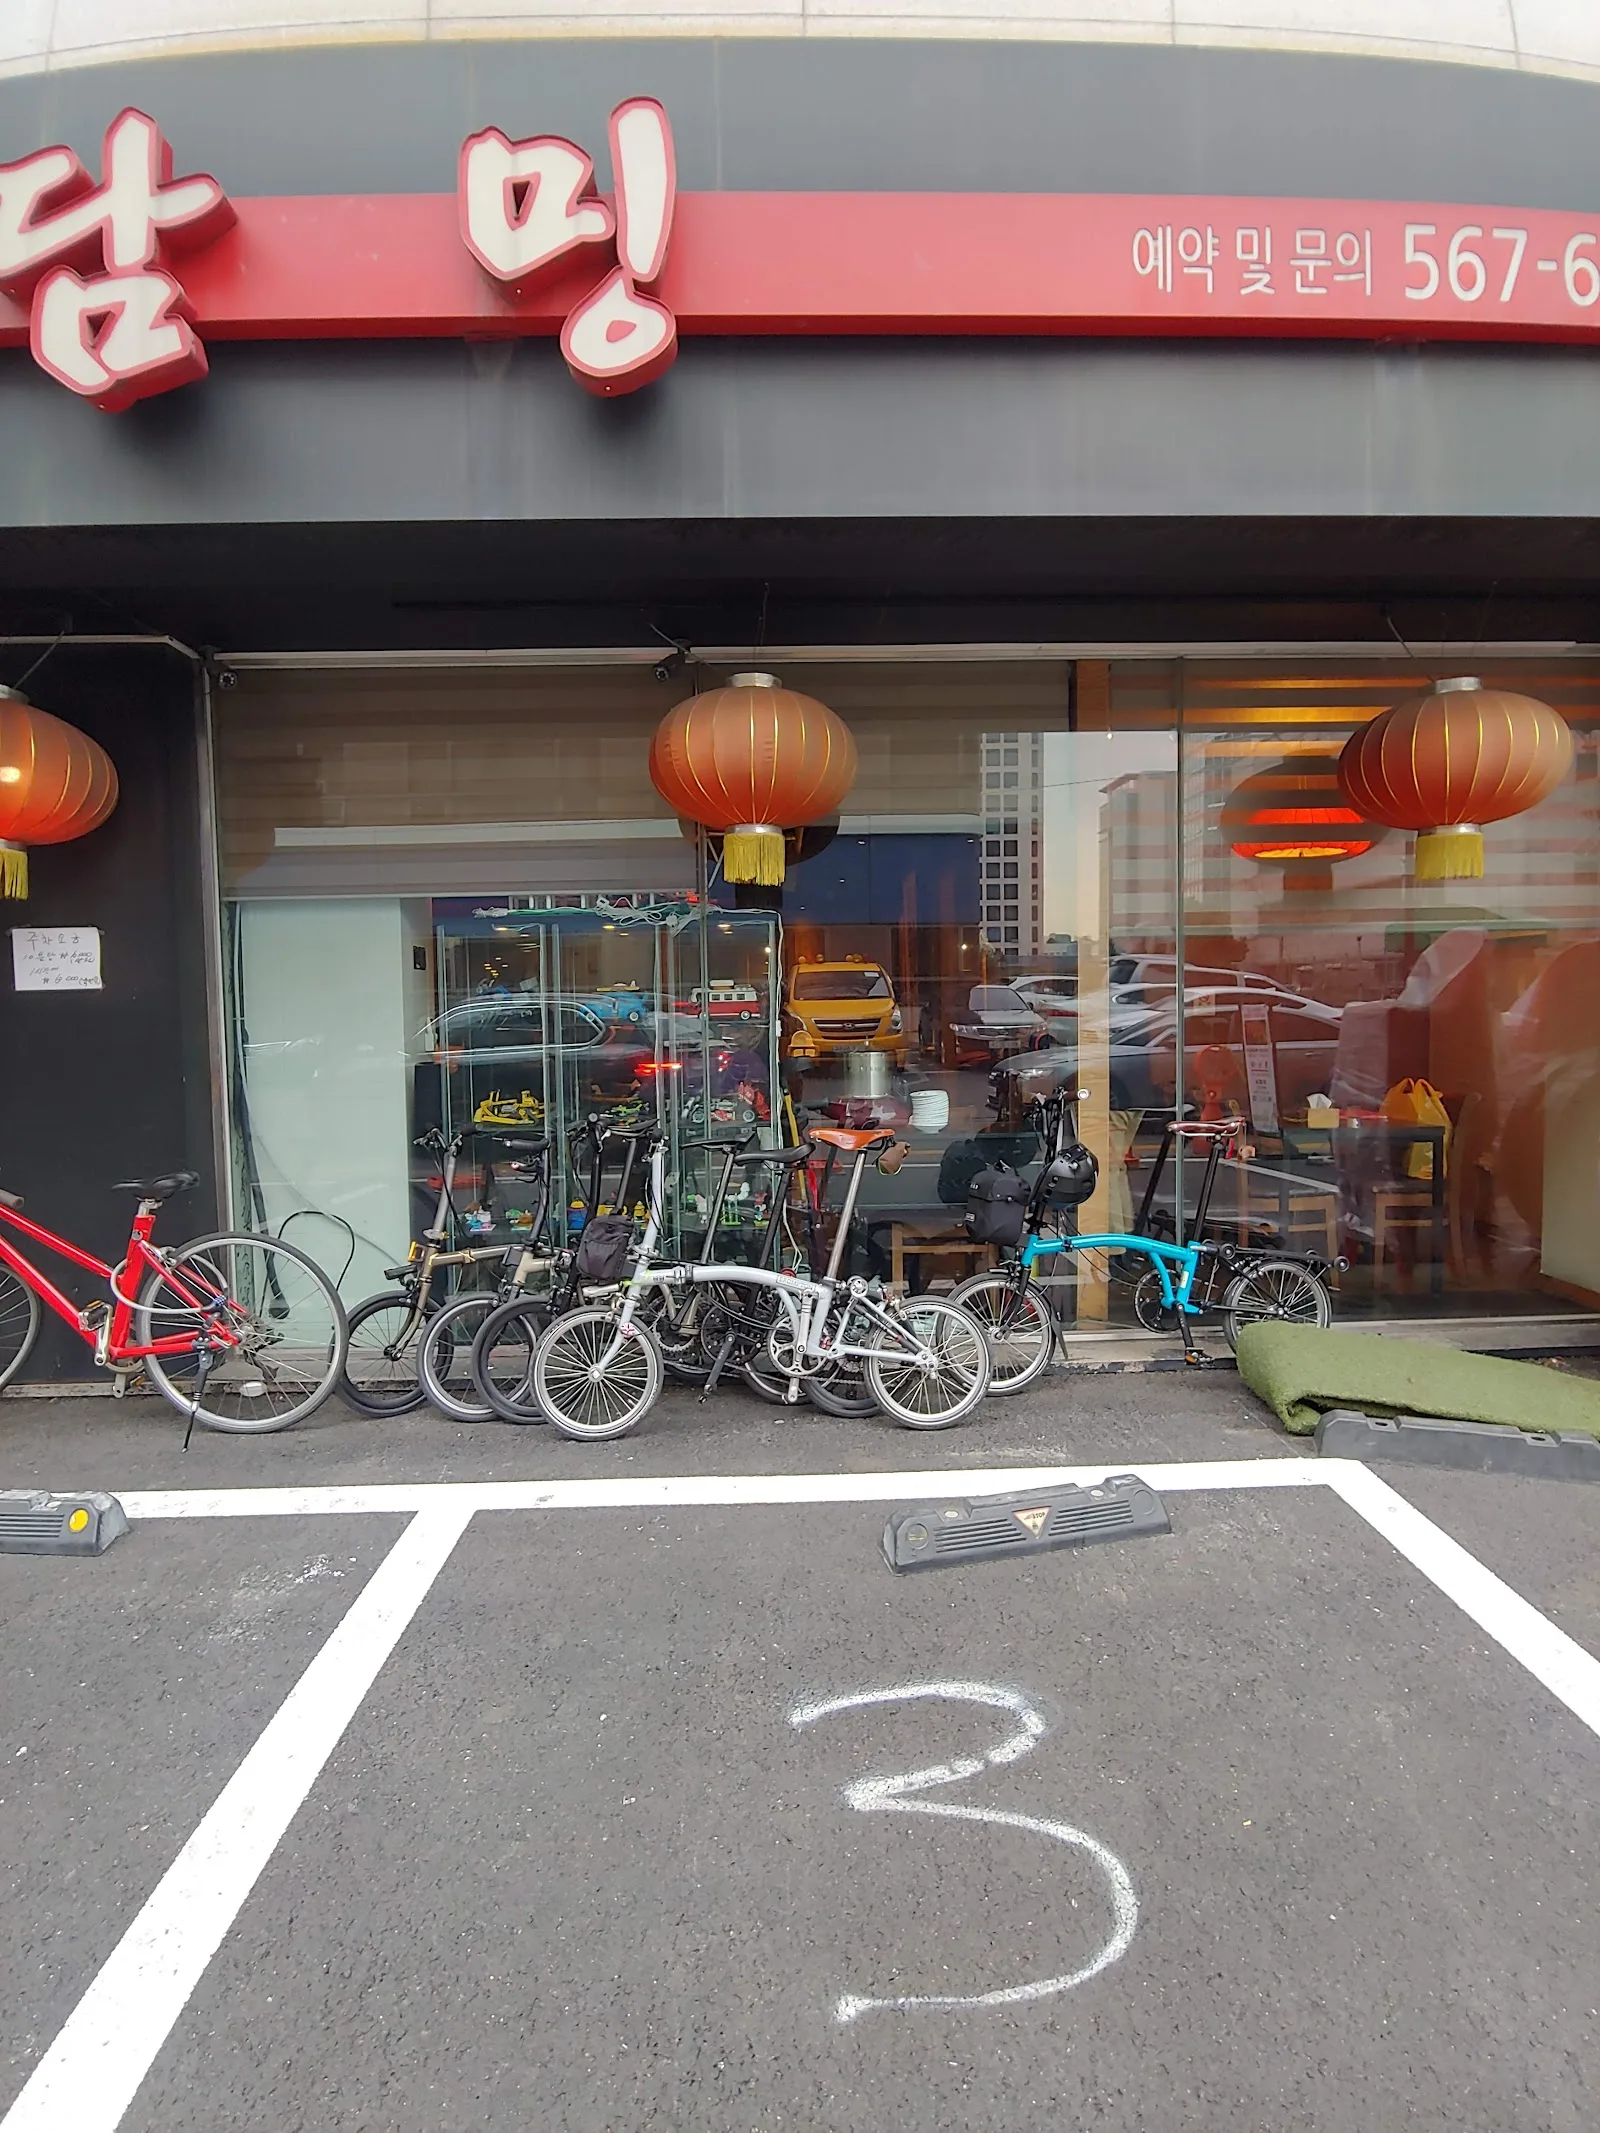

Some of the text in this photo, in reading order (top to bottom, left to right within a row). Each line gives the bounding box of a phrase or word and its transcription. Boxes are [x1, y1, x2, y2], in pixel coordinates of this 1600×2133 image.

[459, 96, 679, 395] 밍
[1132, 224, 1219, 294] 예약
[1235, 226, 1275, 296] 및
[1289, 227, 1373, 297] 문의
[788, 1678, 1140, 2024] 3
